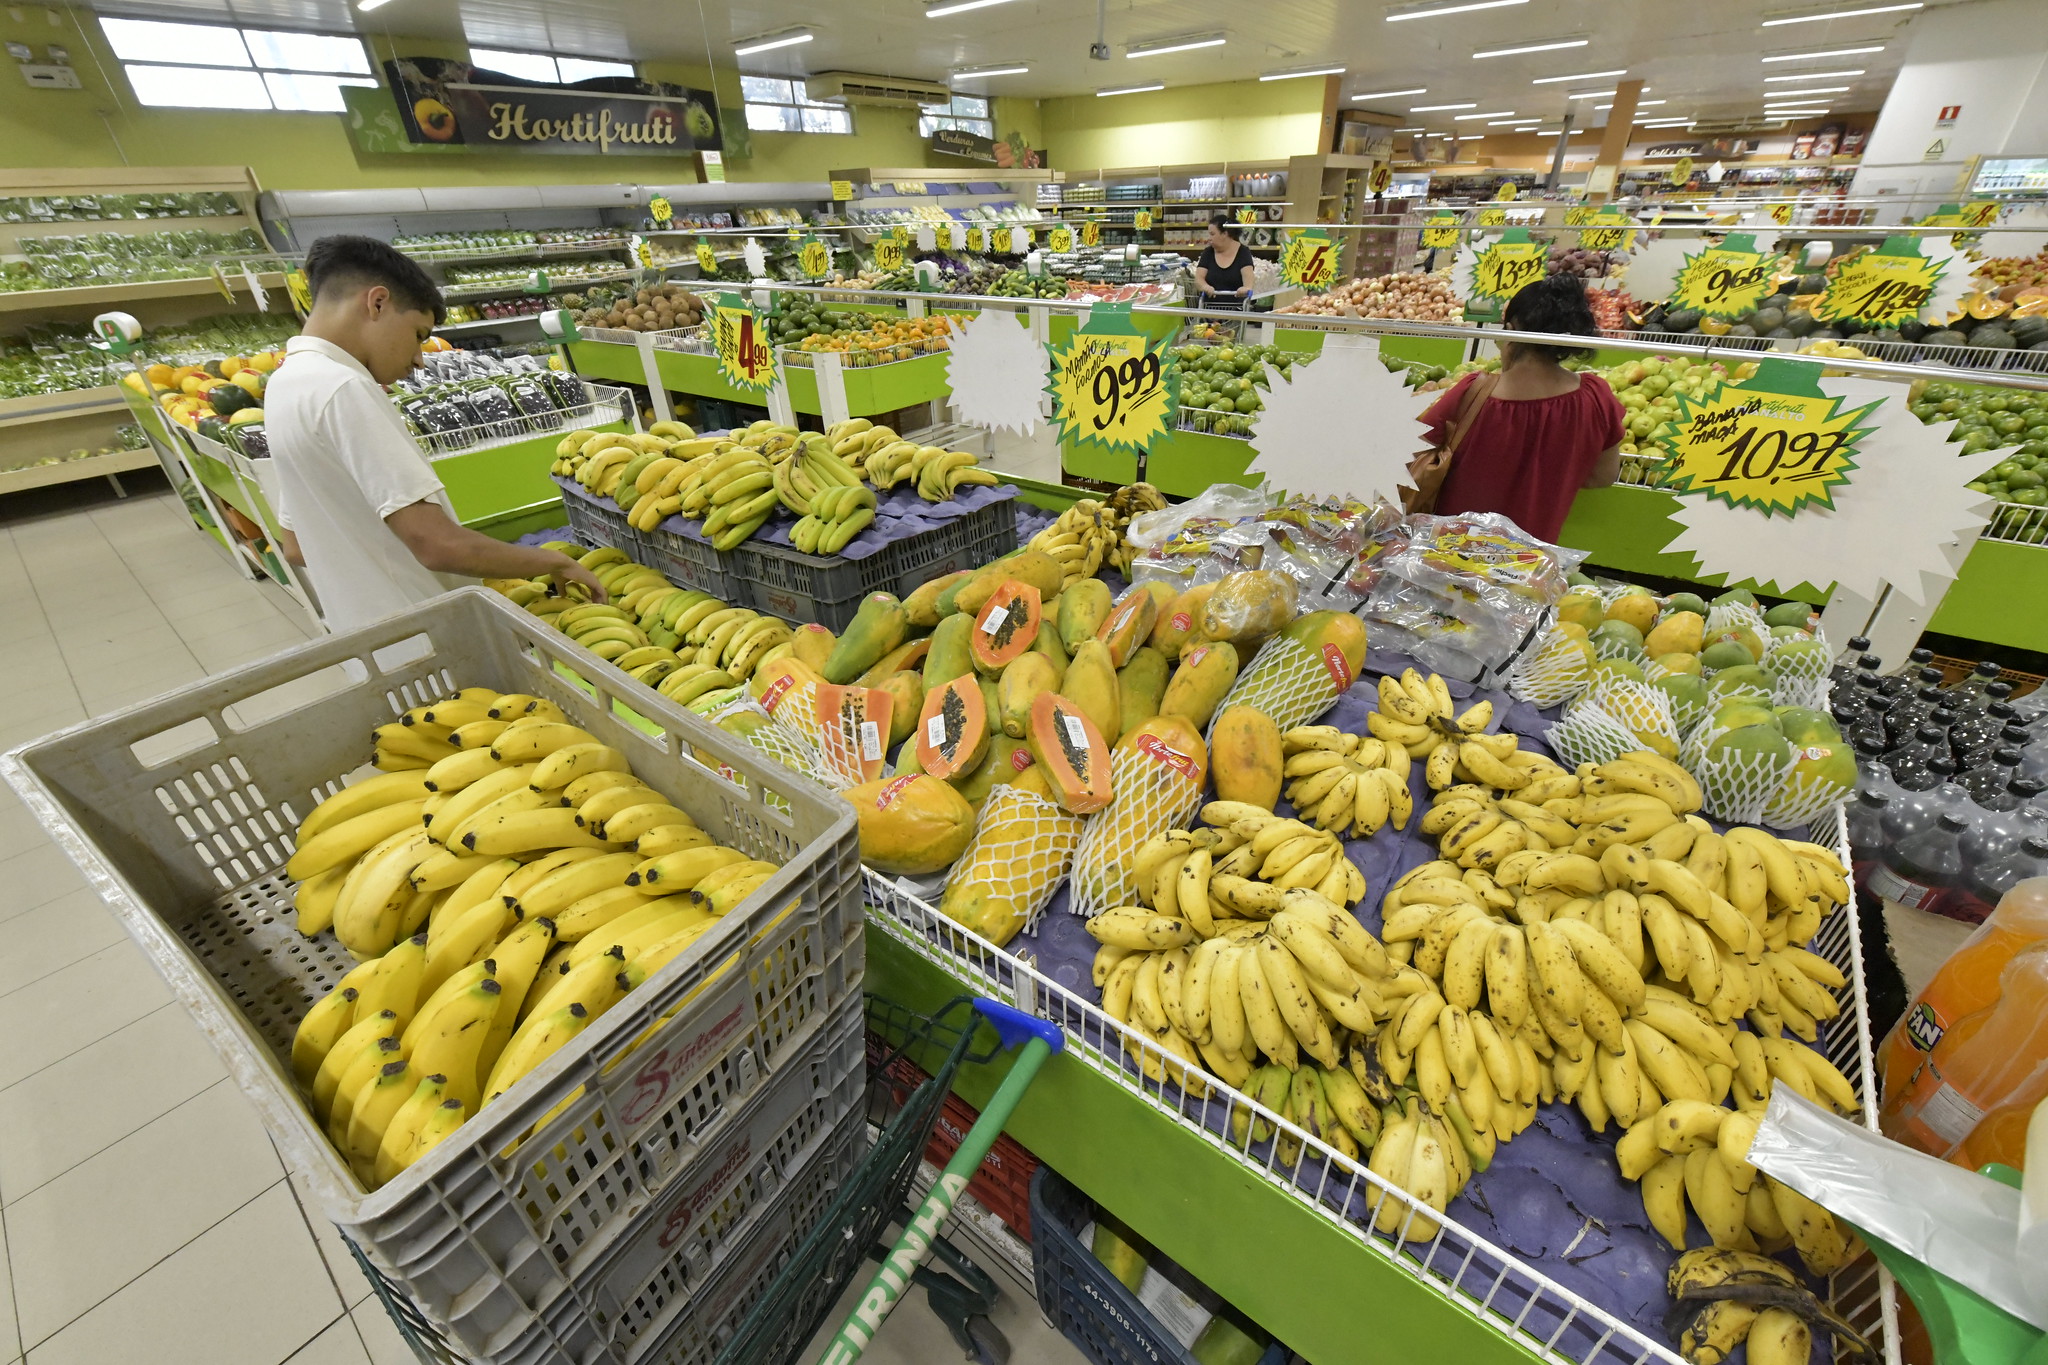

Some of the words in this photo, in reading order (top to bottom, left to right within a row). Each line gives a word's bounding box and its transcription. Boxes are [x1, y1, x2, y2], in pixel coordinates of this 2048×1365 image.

[487, 102, 677, 153] Hortifruti
[939, 131, 974, 146] Verduras
[738, 314, 767, 379] 4,99
